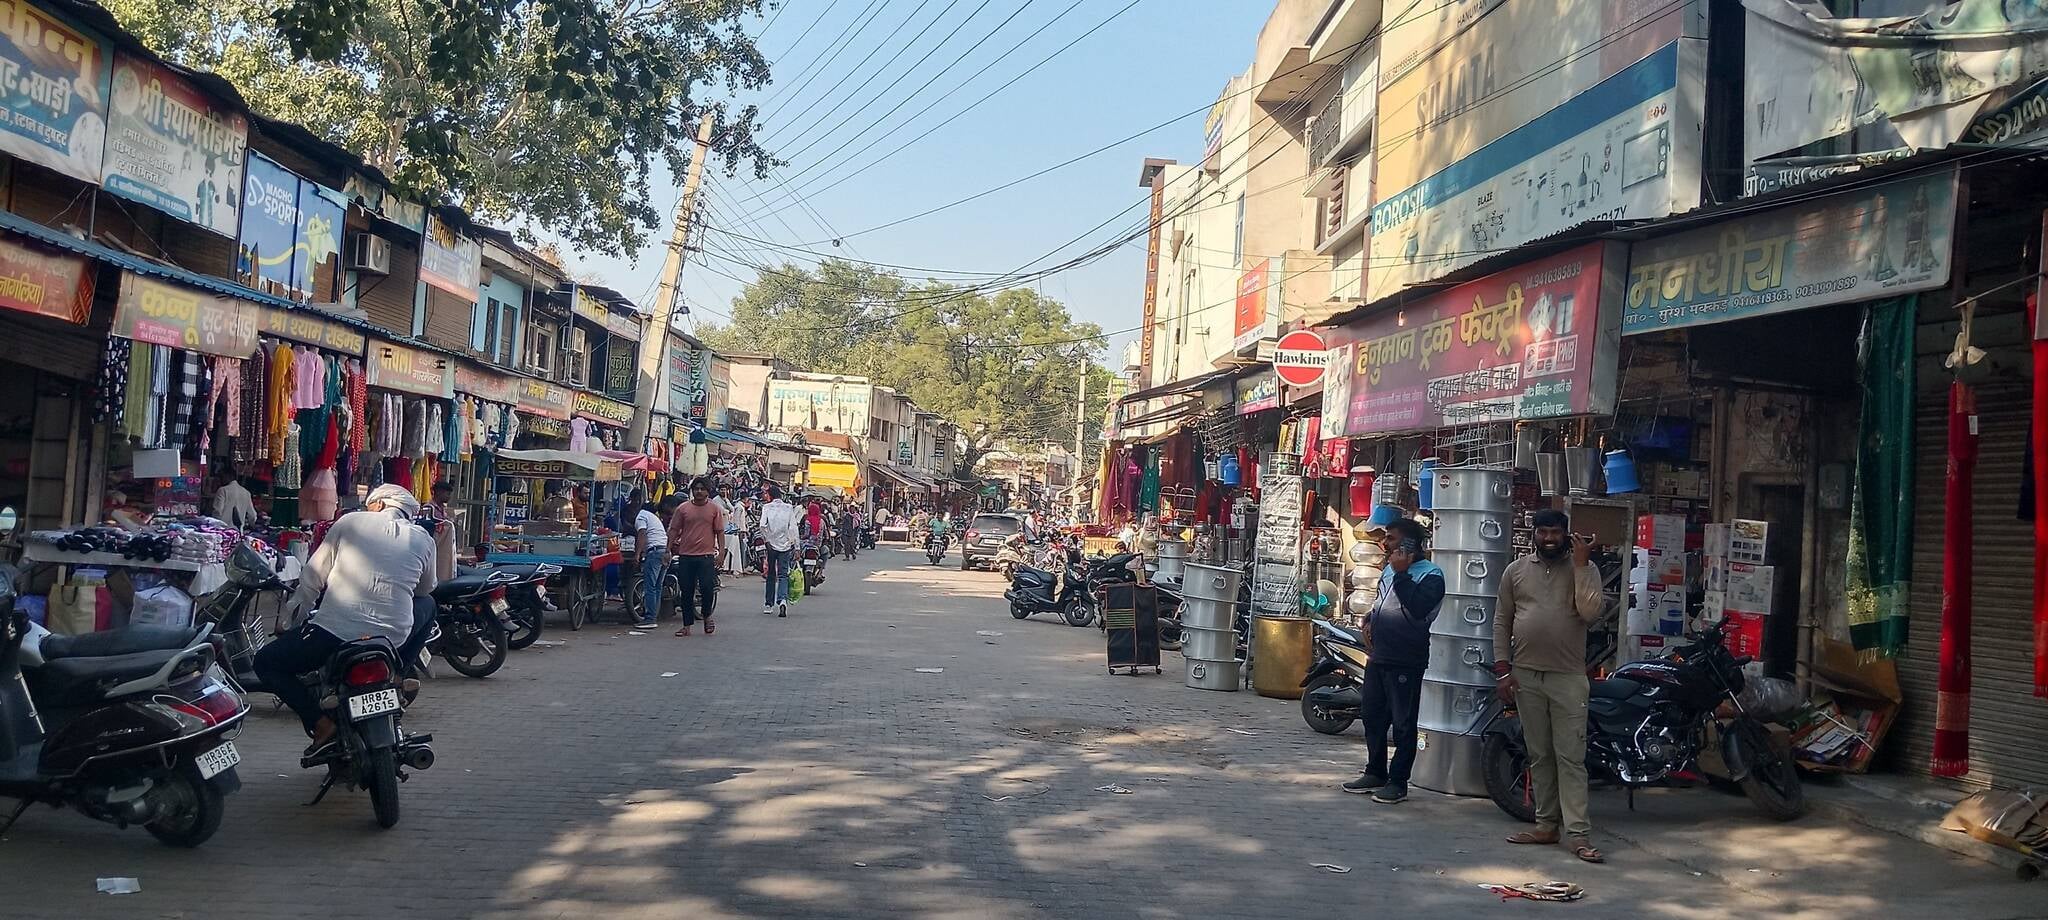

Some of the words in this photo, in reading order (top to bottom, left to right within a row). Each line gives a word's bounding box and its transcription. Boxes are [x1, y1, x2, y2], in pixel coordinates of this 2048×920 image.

[266, 182, 293, 204] MACHO
[264, 194, 304, 228] SPORTO
[1374, 184, 1427, 234] BOROSIL
[1143, 284, 1155, 367] HOUSE
[1273, 351, 1327, 366] Hawkins
[1356, 328, 1418, 387] हनुमान
[1558, 341, 1575, 363] PNB
[361, 691, 390, 705] HR82
[361, 699, 395, 714] A2615
[204, 743, 232, 765] HR36A
[209, 753, 237, 774] F7918
